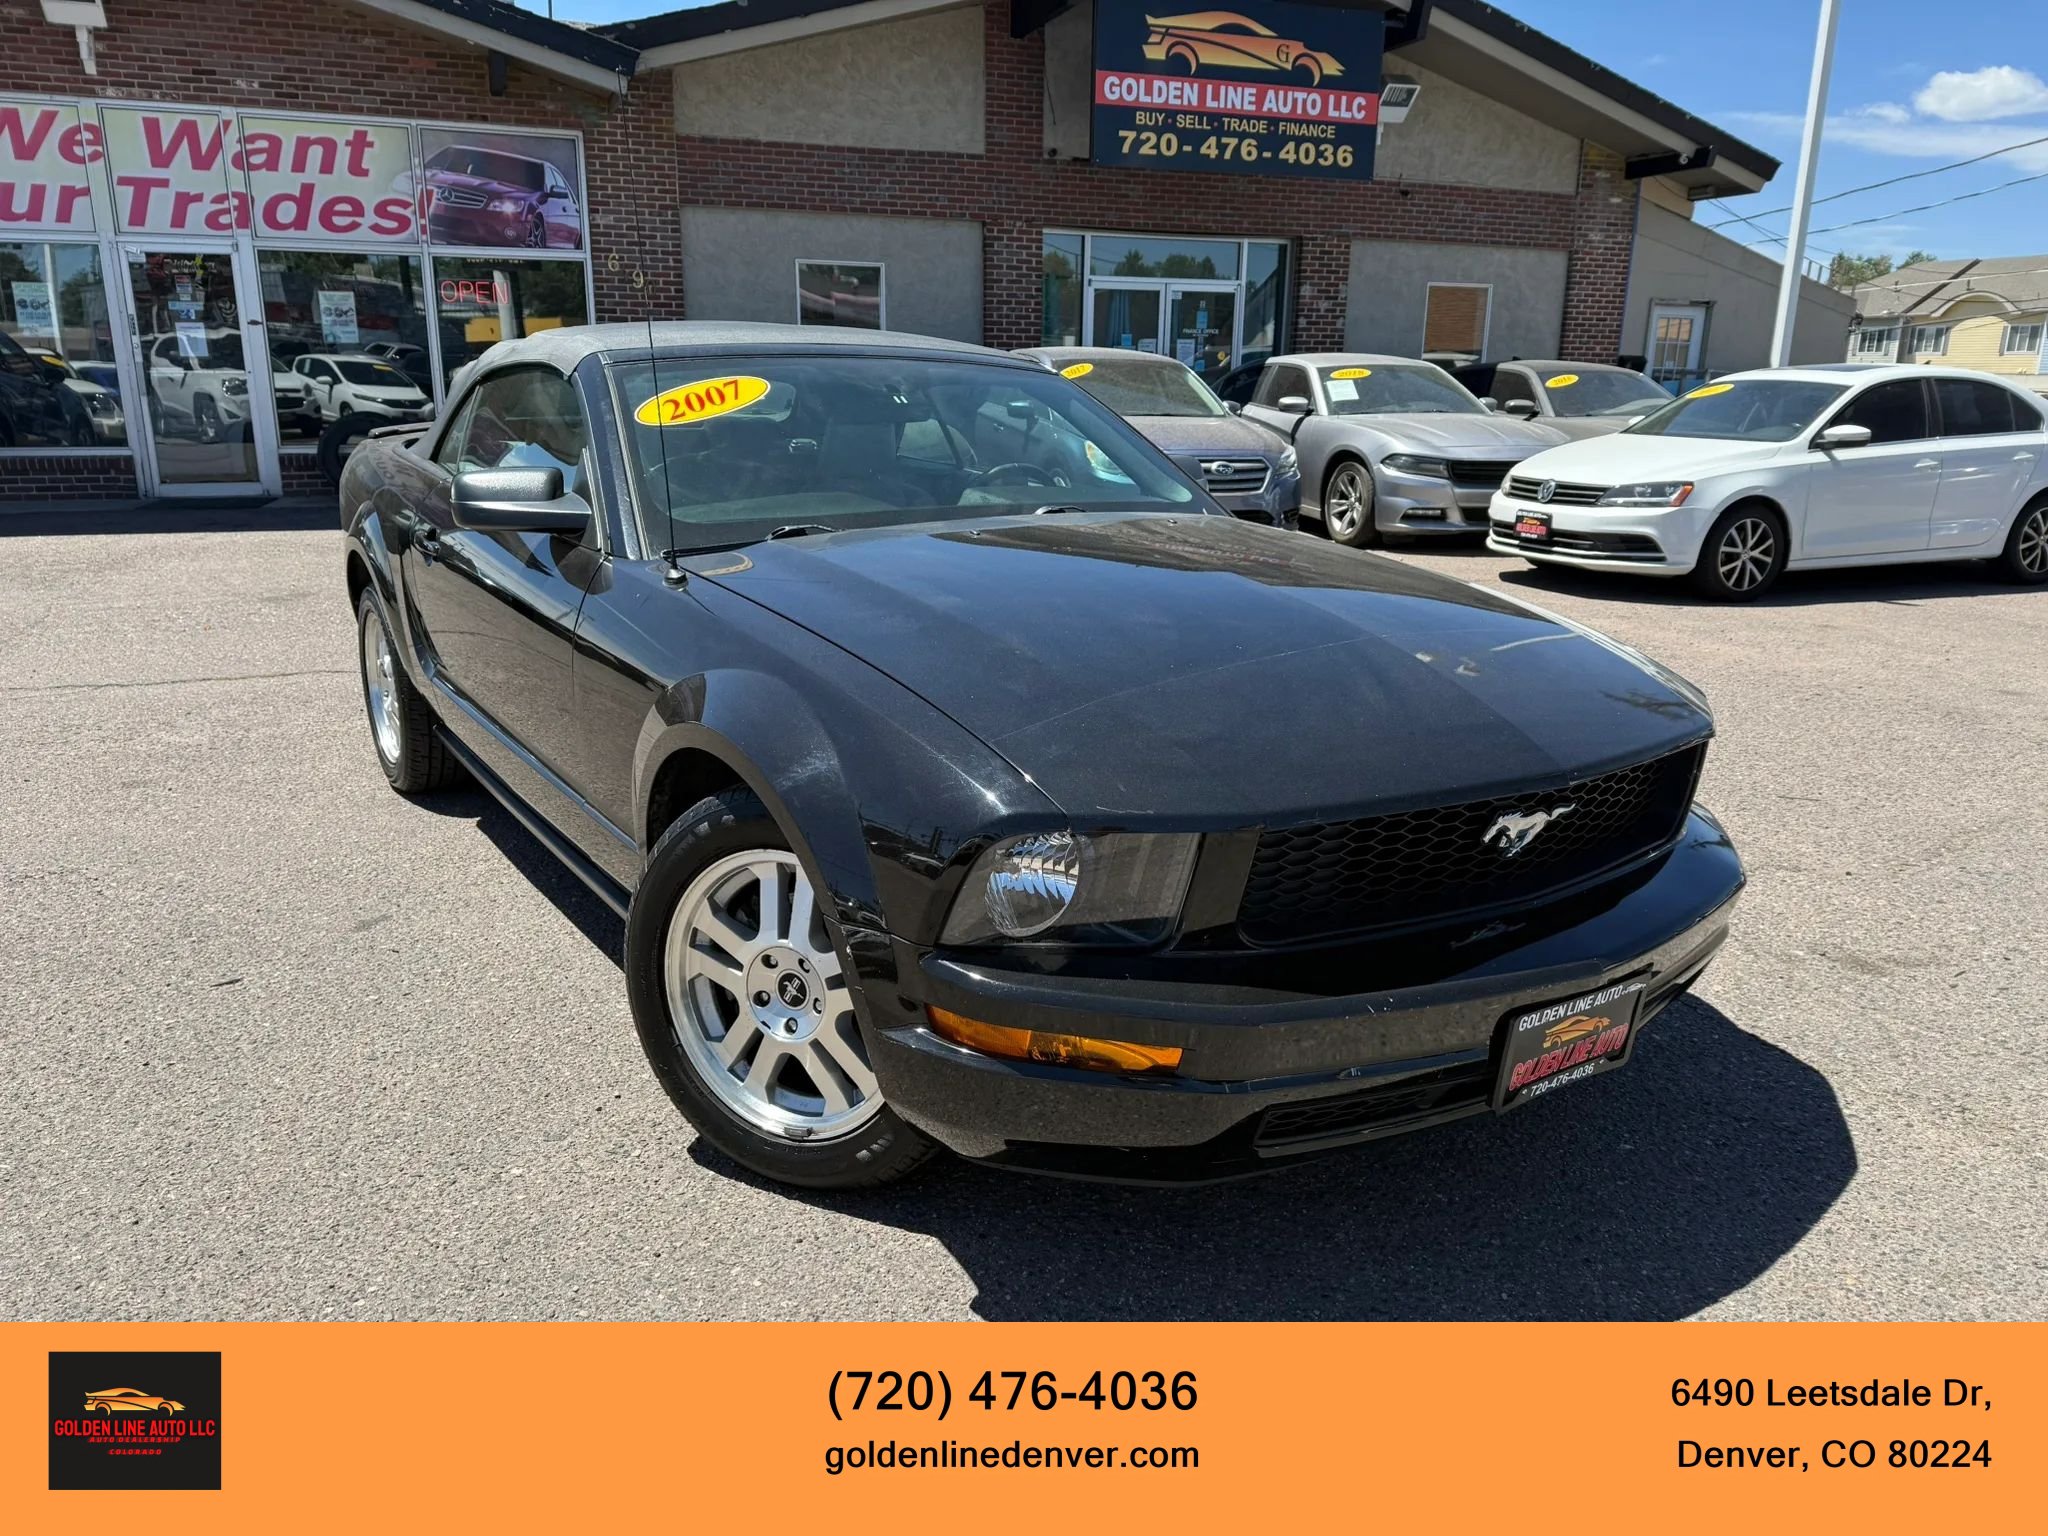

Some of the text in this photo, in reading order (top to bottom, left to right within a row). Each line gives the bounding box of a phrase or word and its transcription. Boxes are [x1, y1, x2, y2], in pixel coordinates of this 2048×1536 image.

[1104, 76, 1367, 120] GOLDEN LINE AUTO LLC
[1135, 111, 1337, 139] BUY SELL TRADE FINANCE
[142, 116, 375, 178] Want
[440, 280, 509, 304] OPEN
[661, 379, 740, 421] 2007
[1519, 1005, 1565, 1032] GOLDEN
[1566, 995, 1595, 1017] LINE
[1509, 1023, 1629, 1091] GOLDEN LINE AUTO
[1530, 1063, 1595, 1097] 720-476-4036
